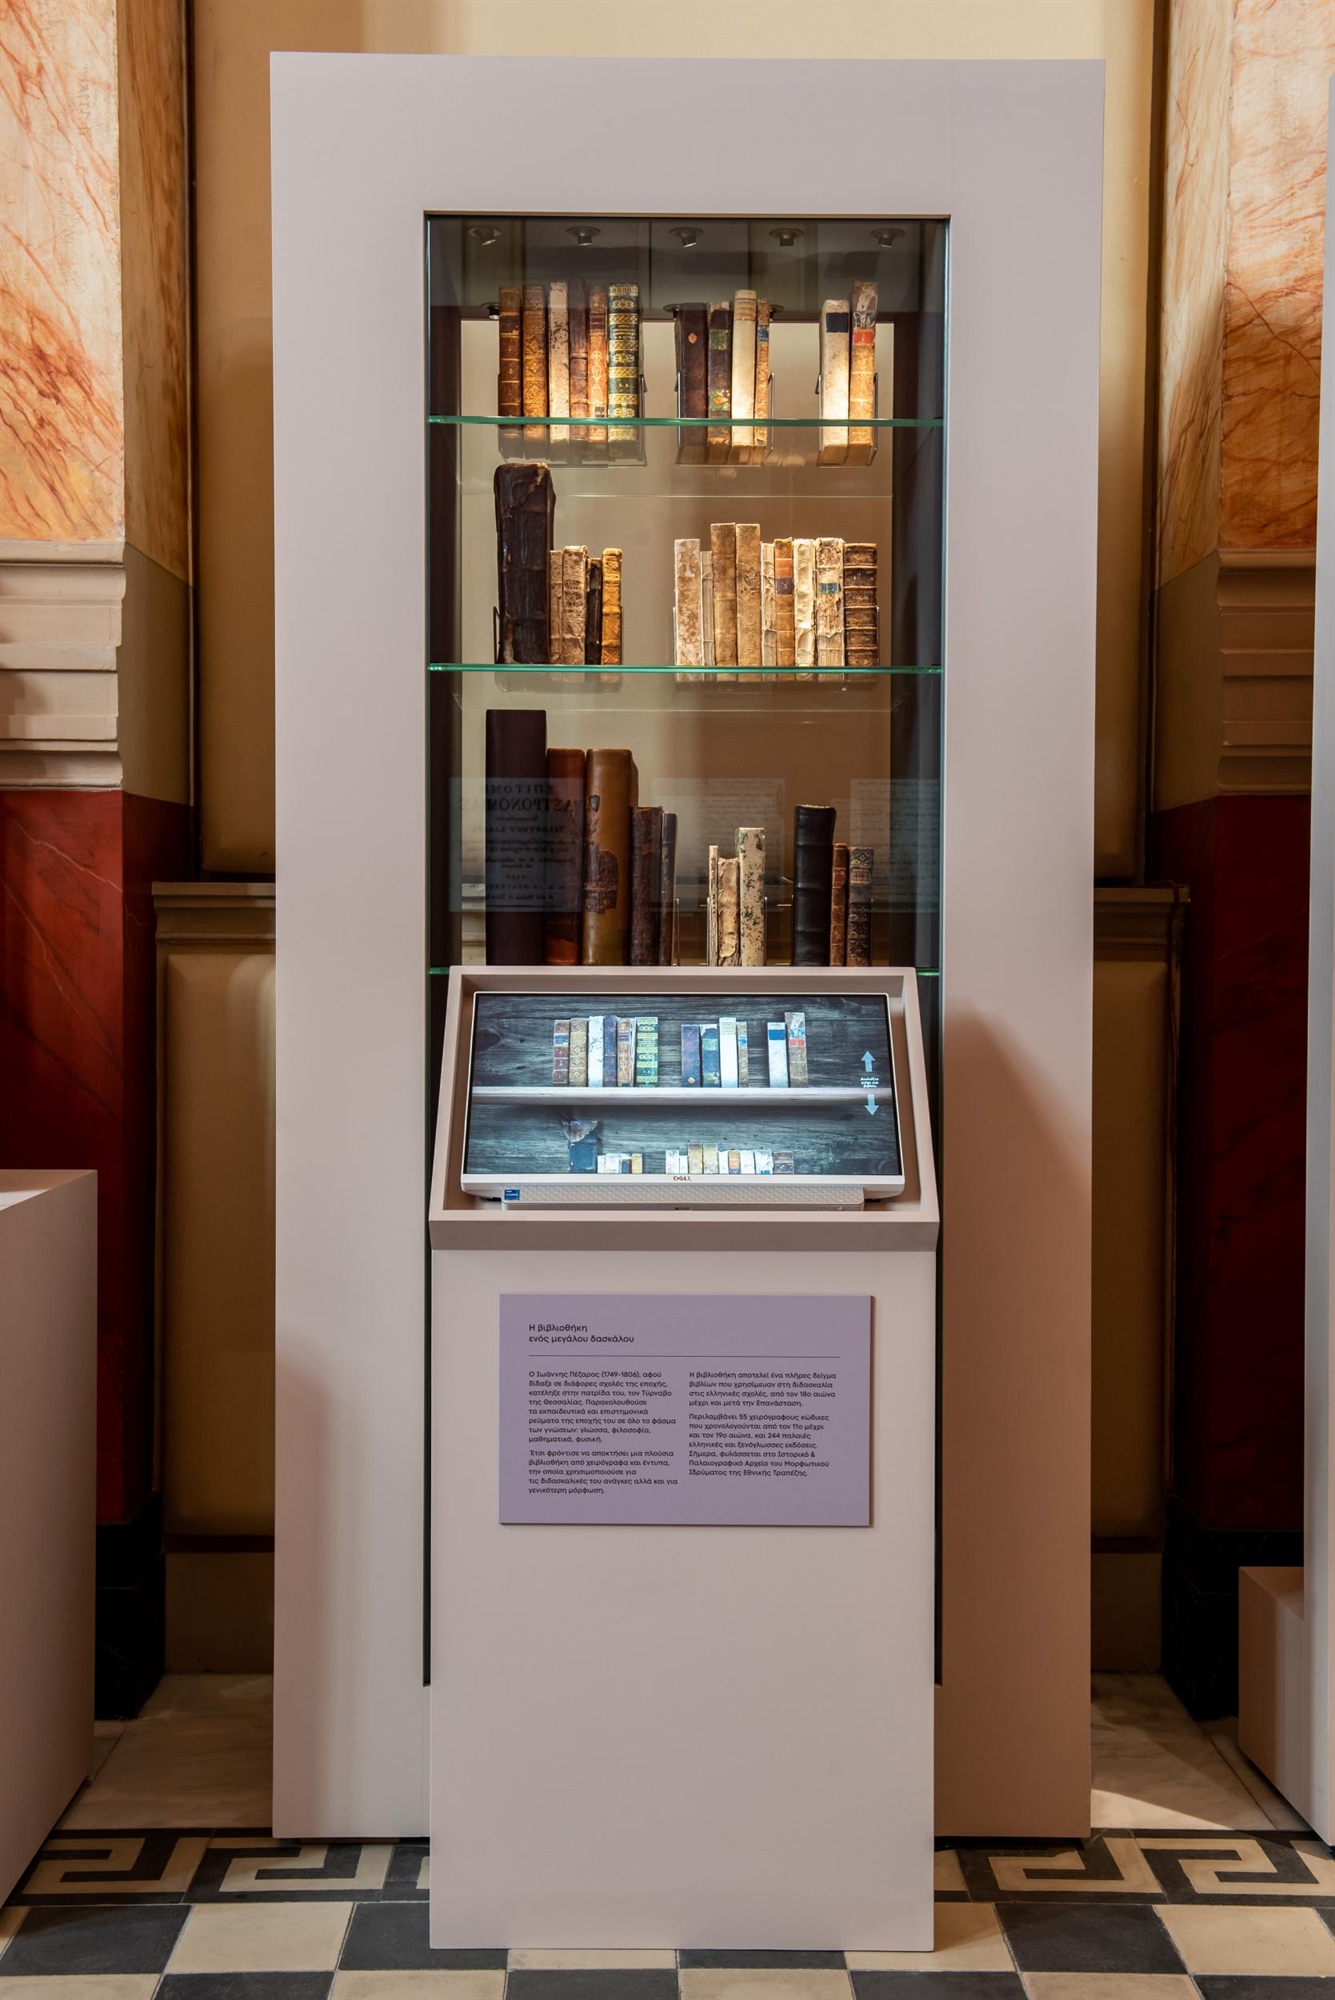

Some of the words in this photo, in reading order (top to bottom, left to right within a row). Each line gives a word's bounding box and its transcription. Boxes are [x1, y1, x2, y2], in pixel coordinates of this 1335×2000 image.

[538, 1324, 587, 1333] βιβλιοθήκη
[529, 1335, 549, 1343] ενός
[551, 1335, 588, 1343] μεγάλου
